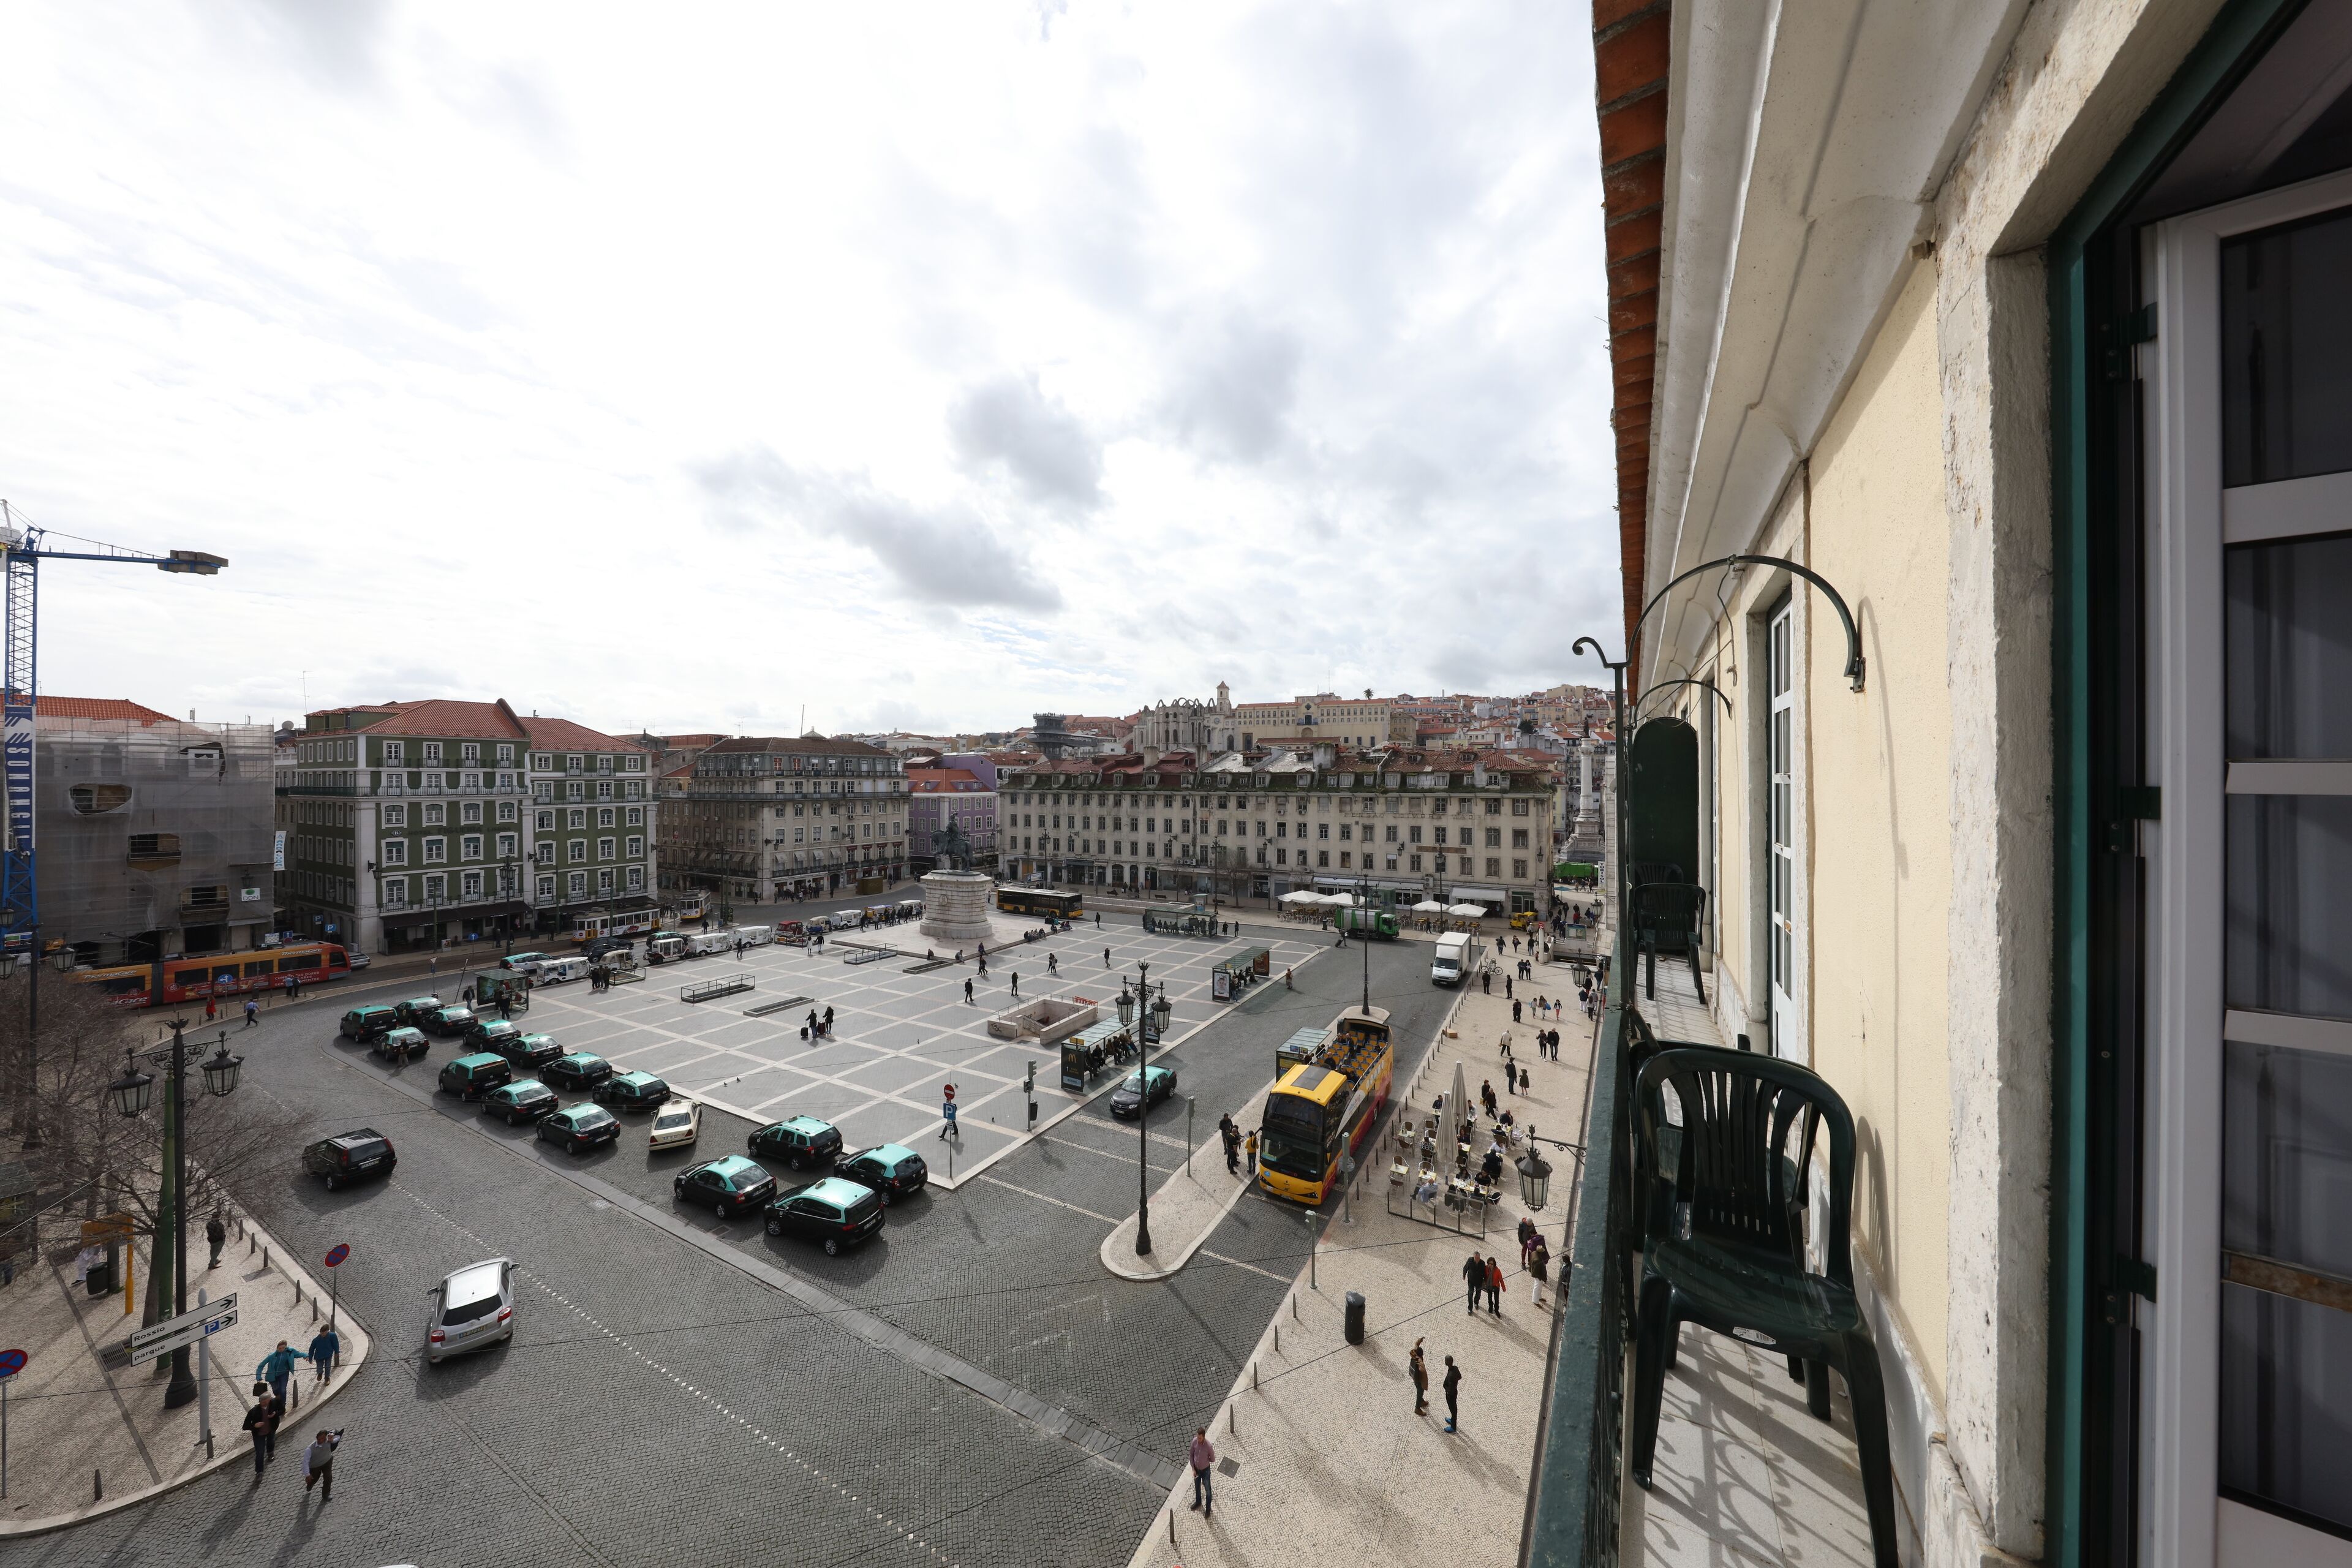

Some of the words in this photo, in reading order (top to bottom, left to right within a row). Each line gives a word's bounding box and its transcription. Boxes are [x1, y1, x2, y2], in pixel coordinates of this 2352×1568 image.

[83, 970, 137, 979] ThermaCare
[946, 1105, 953, 1117] P
[134, 1326, 165, 1342] Rossio
[134, 1344, 165, 1361] parque
